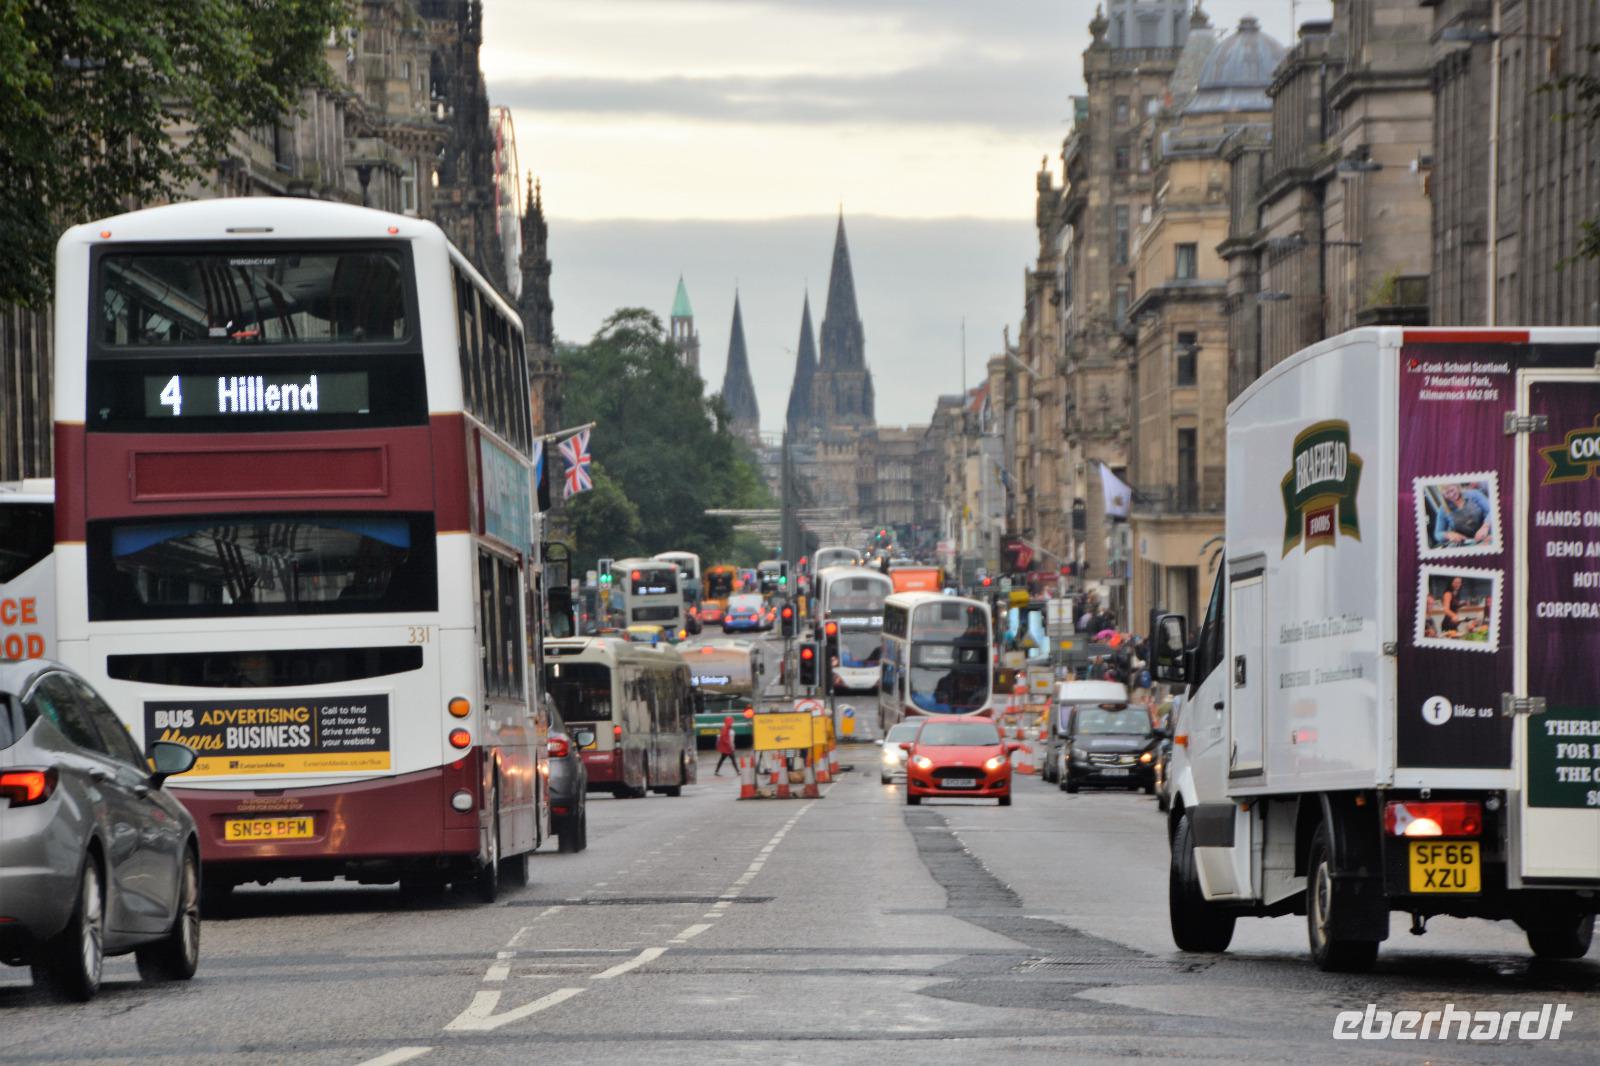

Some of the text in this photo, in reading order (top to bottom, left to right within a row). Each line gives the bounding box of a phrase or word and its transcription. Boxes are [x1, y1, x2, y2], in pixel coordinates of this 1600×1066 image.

[1422, 362, 1442, 373] Cook
[1443, 362, 1471, 373] School
[1472, 362, 1510, 374] Scotland,
[1431, 376, 1469, 386] Moorfield
[160, 375, 318, 416] 4 Hillend
[1419, 390, 1465, 400] Kilmarnock
[1296, 441, 1347, 495] BRAEHEAD
[1310, 514, 1331, 536] FOODS
[1536, 511, 1581, 527] HANDS
[1546, 541, 1583, 557] DEMO
[1573, 571, 1600, 588] HOT
[0, 597, 38, 626] CE
[1537, 602, 1600, 618] CORPORA
[408, 626, 430, 644] 331
[0, 633, 46, 661] OD
[155, 707, 310, 729] BUS ADVERTISING
[321, 706, 338, 715] Call
[350, 705, 367, 714] find
[1454, 704, 1476, 717] like
[1478, 706, 1494, 718] us
[337, 717, 356, 725] how
[226, 725, 311, 750] BUSINESS
[321, 728, 344, 736] drive
[344, 726, 370, 735] traffic
[322, 737, 376, 748] your website
[1556, 743, 1590, 759] FOR
[1556, 766, 1591, 782] THE
[231, 820, 307, 838] SN59 BFM
[1416, 844, 1473, 864] SF66
[1424, 868, 1467, 888] XZU
